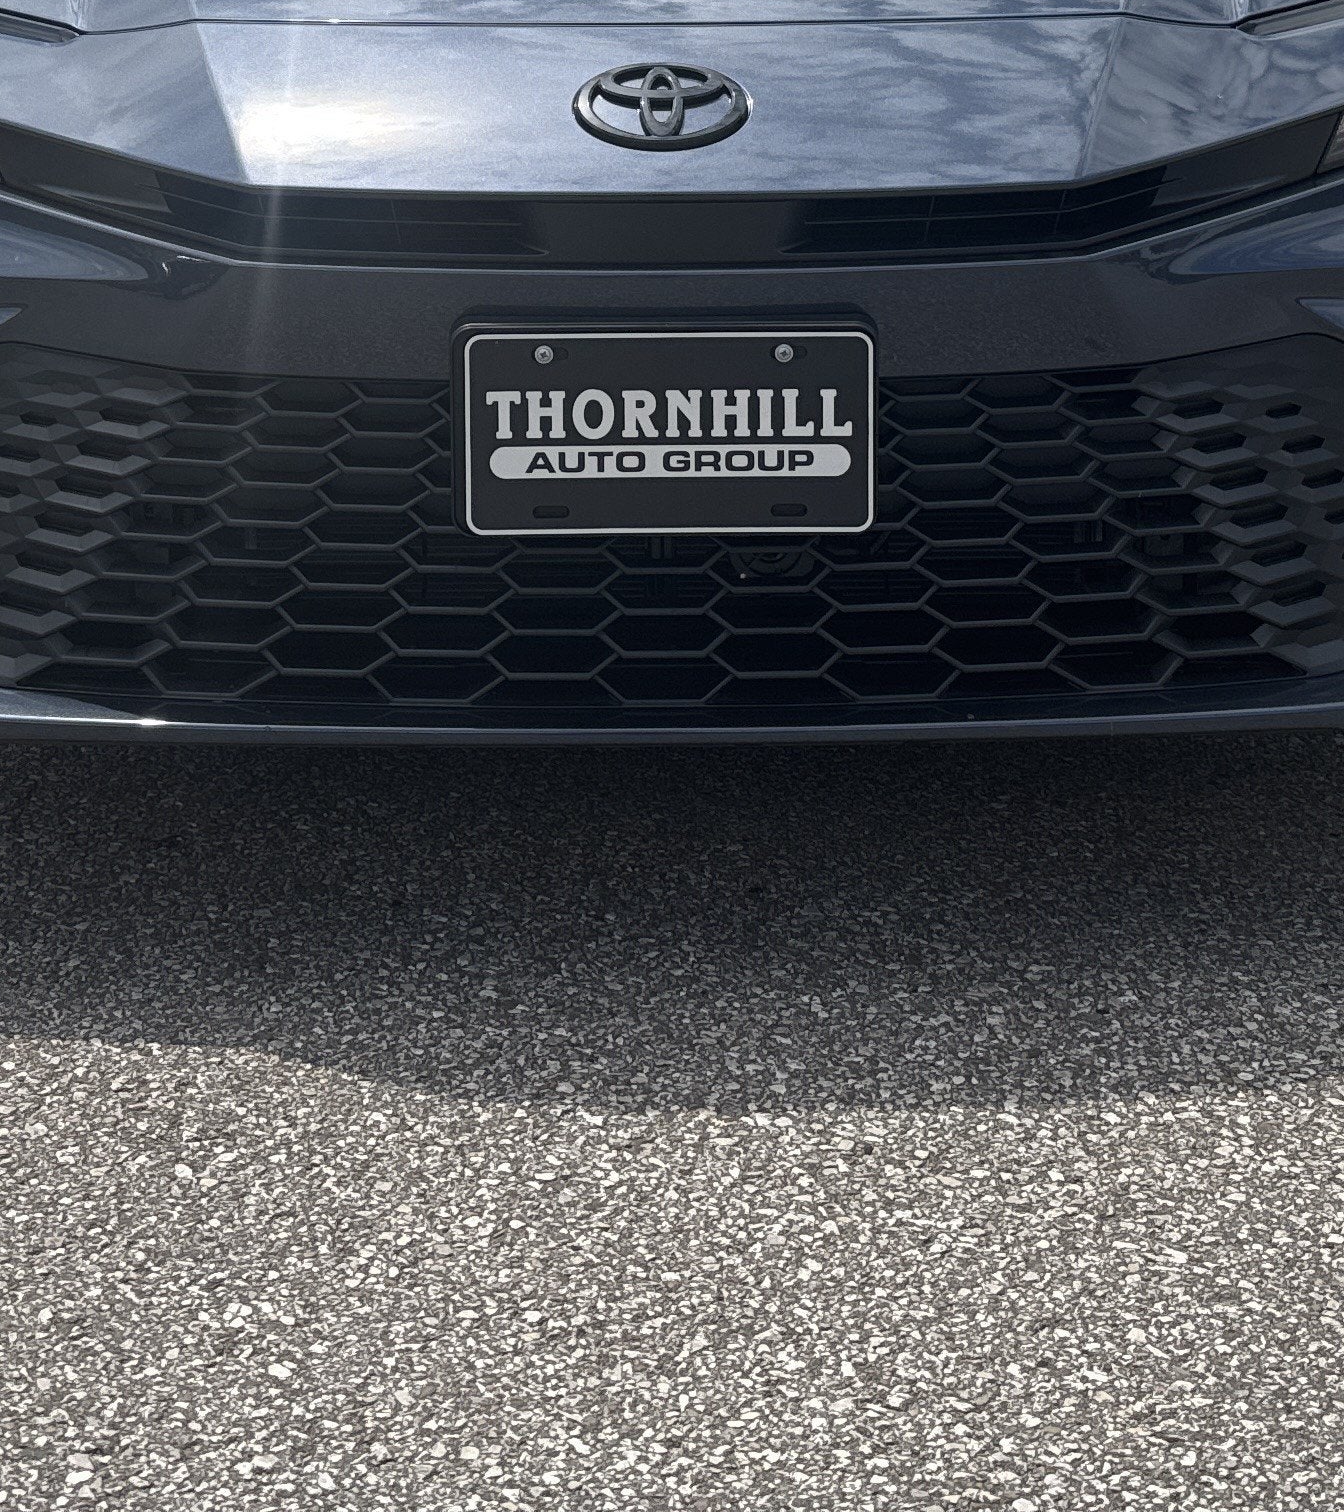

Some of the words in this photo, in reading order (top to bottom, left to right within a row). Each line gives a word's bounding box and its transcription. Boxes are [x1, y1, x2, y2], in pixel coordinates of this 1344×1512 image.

[485, 388, 853, 440] THORNHILL
[525, 450, 647, 474] AUTO
[662, 449, 815, 473] GROUP
